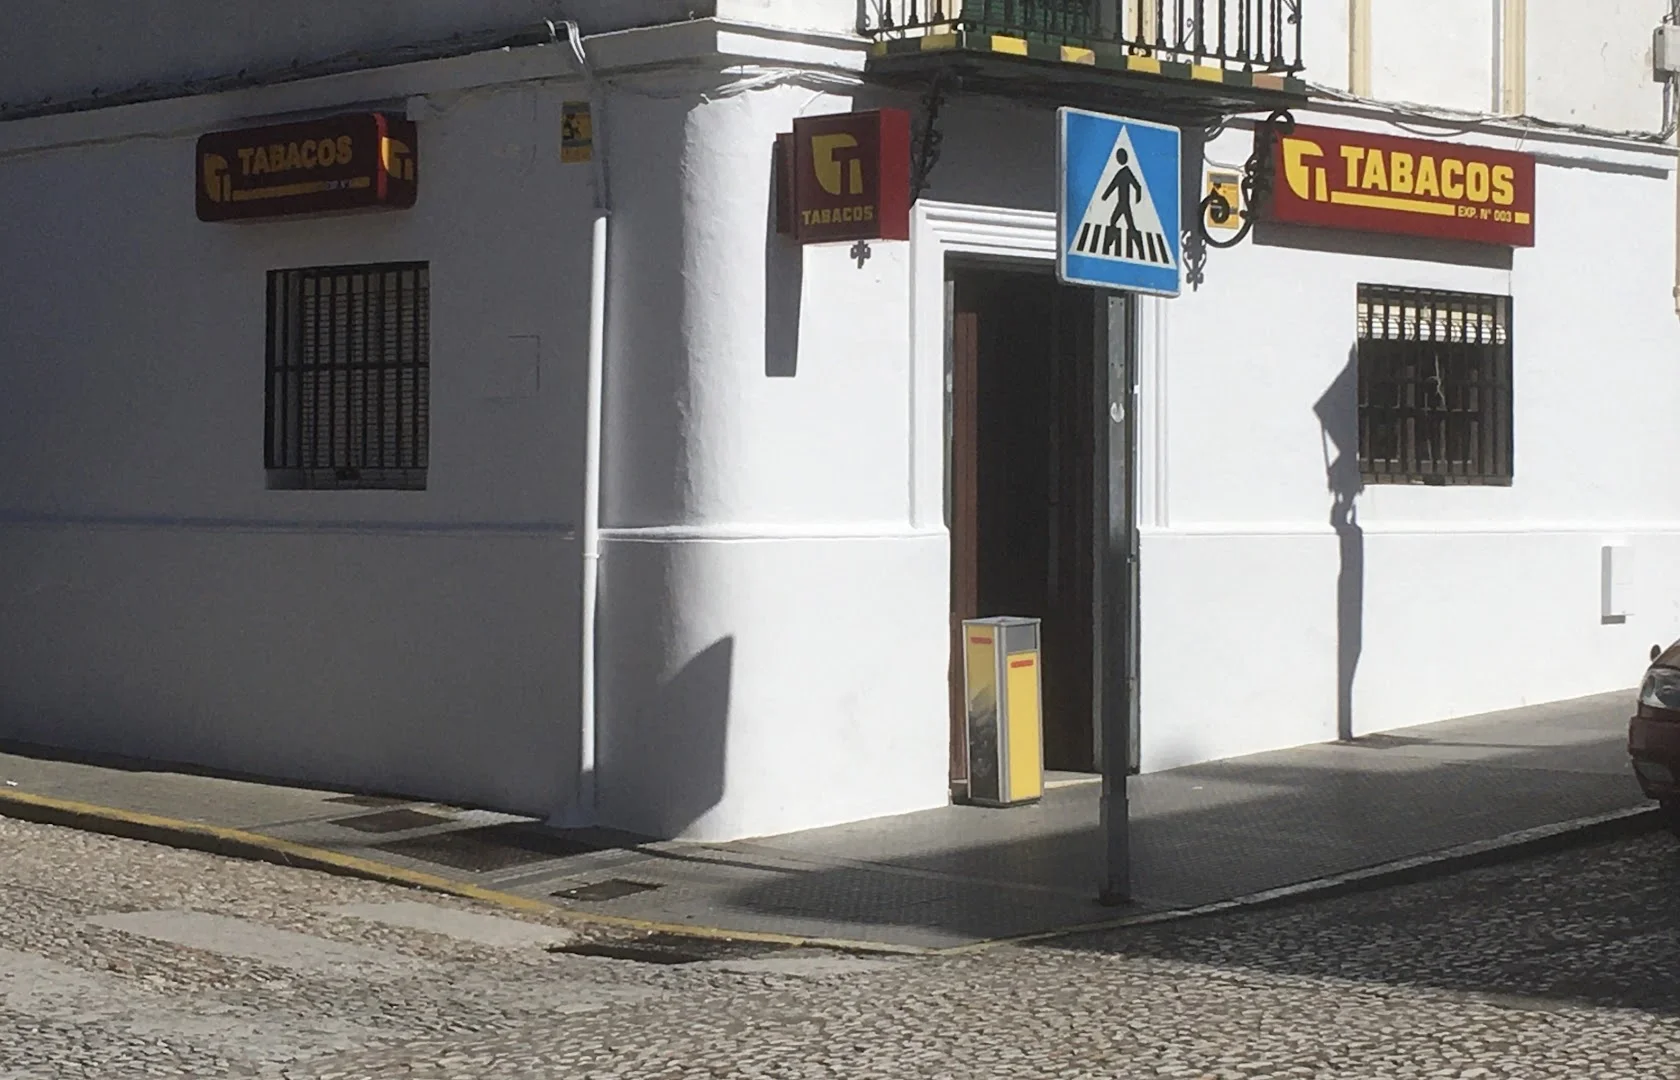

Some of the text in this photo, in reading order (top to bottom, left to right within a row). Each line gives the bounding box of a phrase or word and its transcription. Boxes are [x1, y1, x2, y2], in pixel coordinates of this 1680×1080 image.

[238, 136, 352, 175] TABACOS
[1340, 145, 1514, 205] TABACOS
[802, 206, 874, 225] TABACOS
